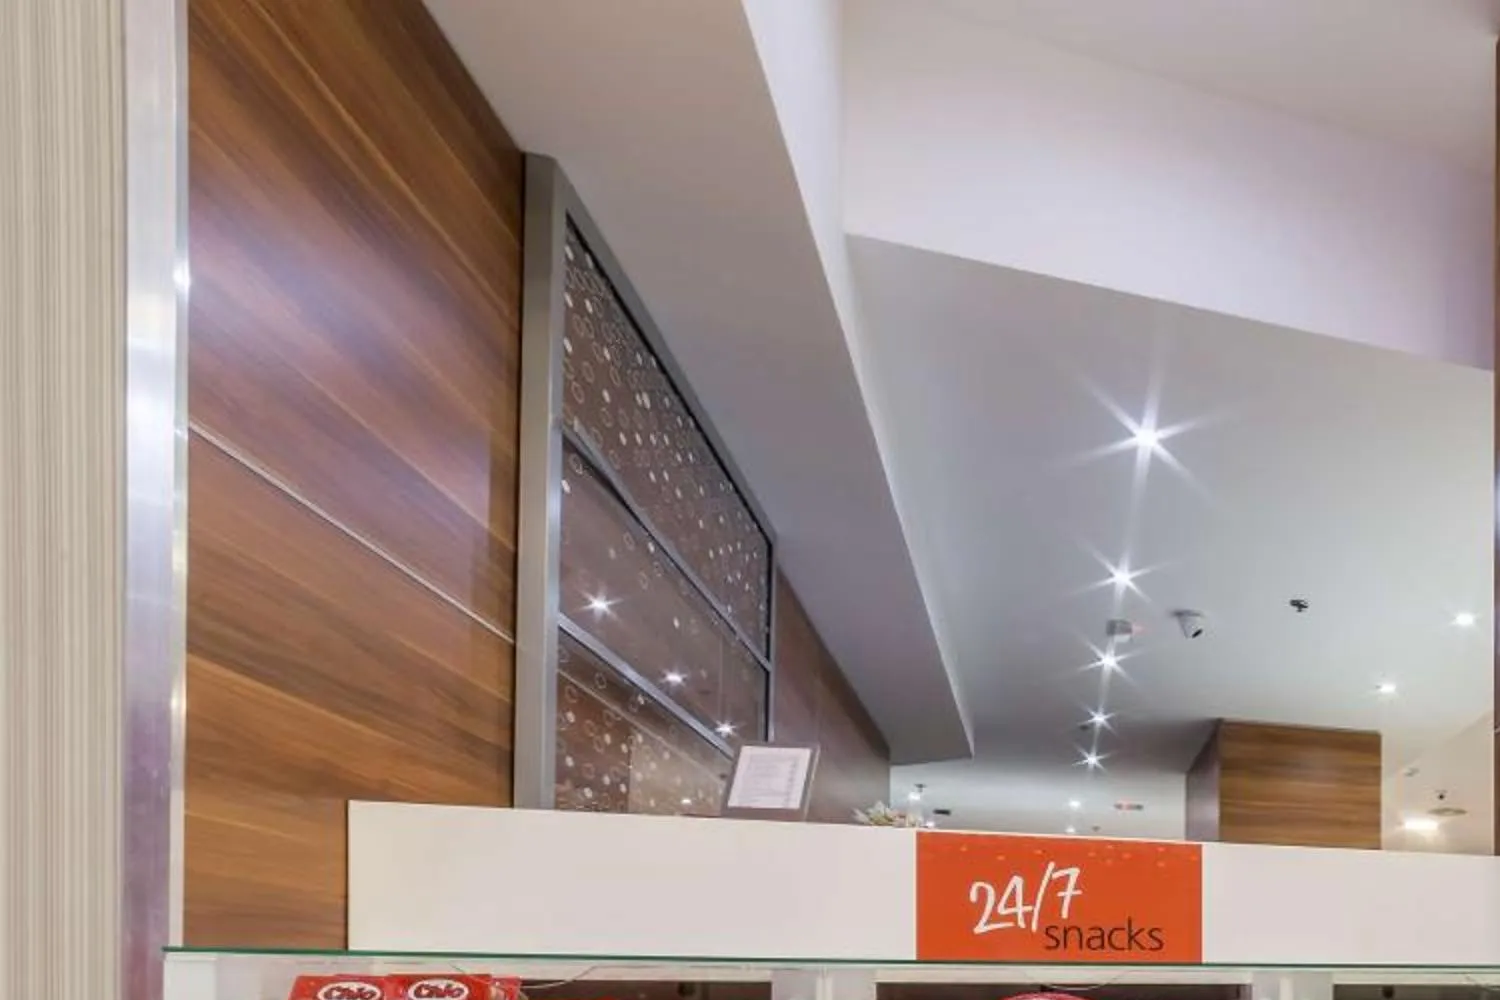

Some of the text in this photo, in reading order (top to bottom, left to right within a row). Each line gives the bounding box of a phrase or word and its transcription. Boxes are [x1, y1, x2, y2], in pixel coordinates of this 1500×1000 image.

[969, 861, 1083, 935] 24/7
[1044, 916, 1165, 952] snacks
[324, 984, 378, 1000] Chio
[414, 980, 466, 999] Chio
